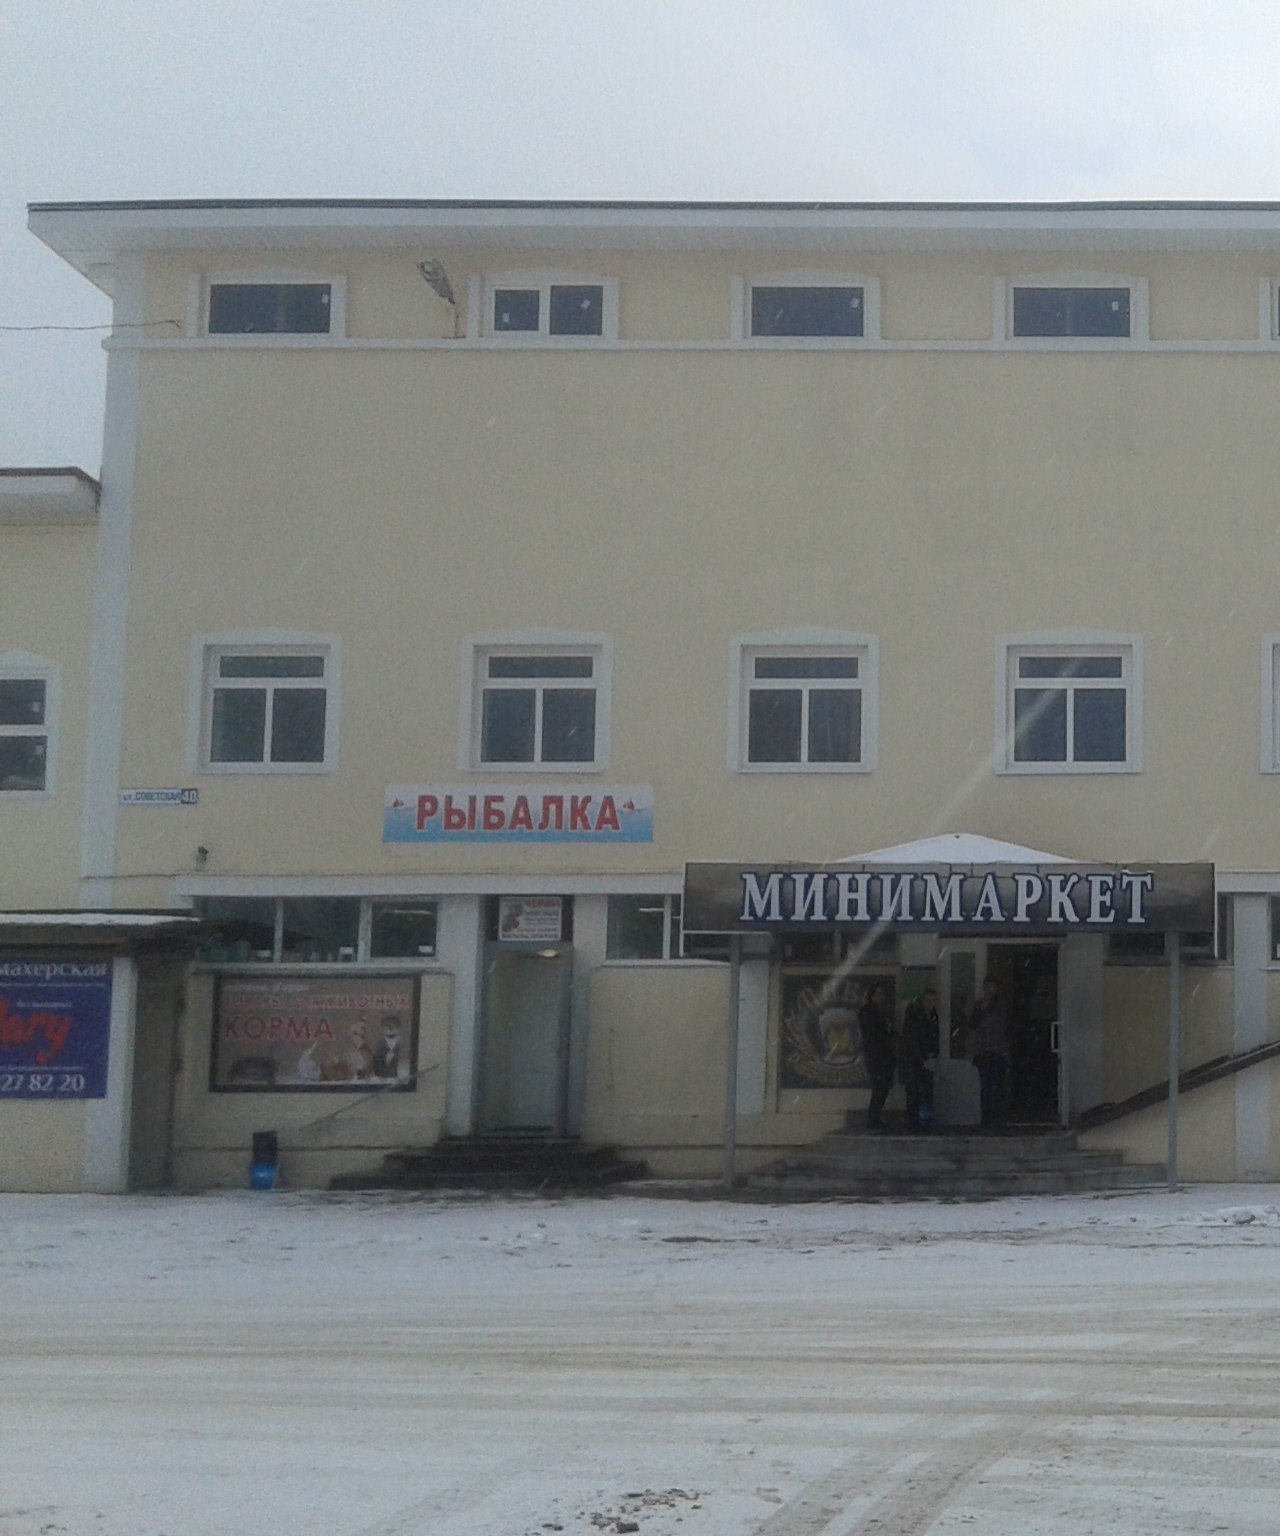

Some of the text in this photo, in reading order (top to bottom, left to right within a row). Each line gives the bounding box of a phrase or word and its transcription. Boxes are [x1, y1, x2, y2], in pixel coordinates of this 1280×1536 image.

[181, 789, 198, 804] 40
[416, 795, 621, 831] РЫБАЛКА
[739, 872, 1155, 924] МИНИМАРКЕТ
[224, 1015, 334, 1041] КОРМА
[1, 1074, 86, 1092] 27 82 20
